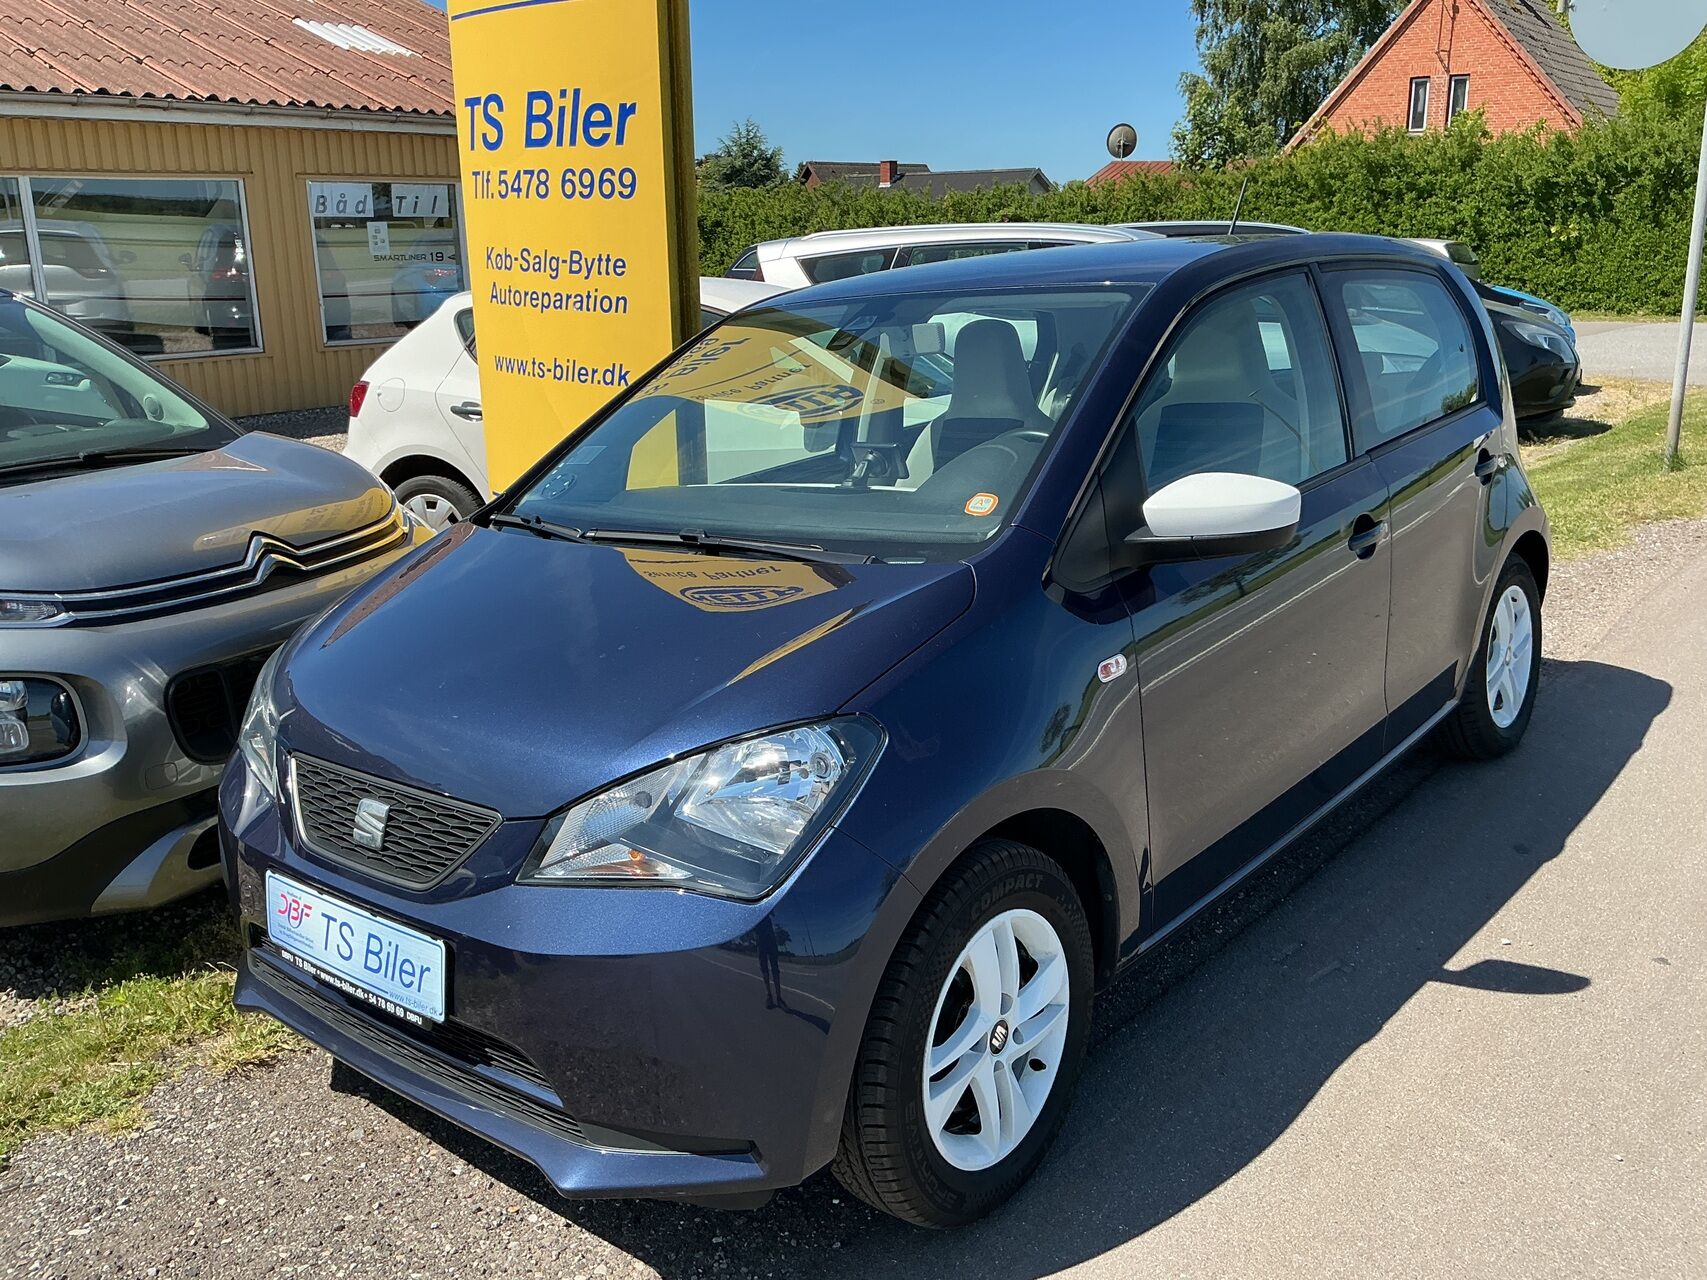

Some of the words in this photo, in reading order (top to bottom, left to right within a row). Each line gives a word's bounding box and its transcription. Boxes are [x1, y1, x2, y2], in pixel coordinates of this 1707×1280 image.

[464, 93, 504, 151] TS
[524, 87, 637, 148] Biler
[560, 167, 637, 200] 6969
[315, 192, 368, 214] Båd
[396, 195, 438, 214] Til
[373, 254, 427, 262] SMARTLINER
[429, 252, 445, 262] 19
[485, 246, 627, 280] Køb-Salg-Bytte
[489, 281, 628, 314] Autoreparation
[494, 355, 631, 388] www.ts-biler.dk
[971, 873, 1043, 920] COMPACT
[321, 912, 355, 961] TS
[363, 932, 431, 993] Biler
[368, 993, 377, 1004] 54
[377, 998, 386, 1009] 78
[395, 1006, 404, 1018] 69
